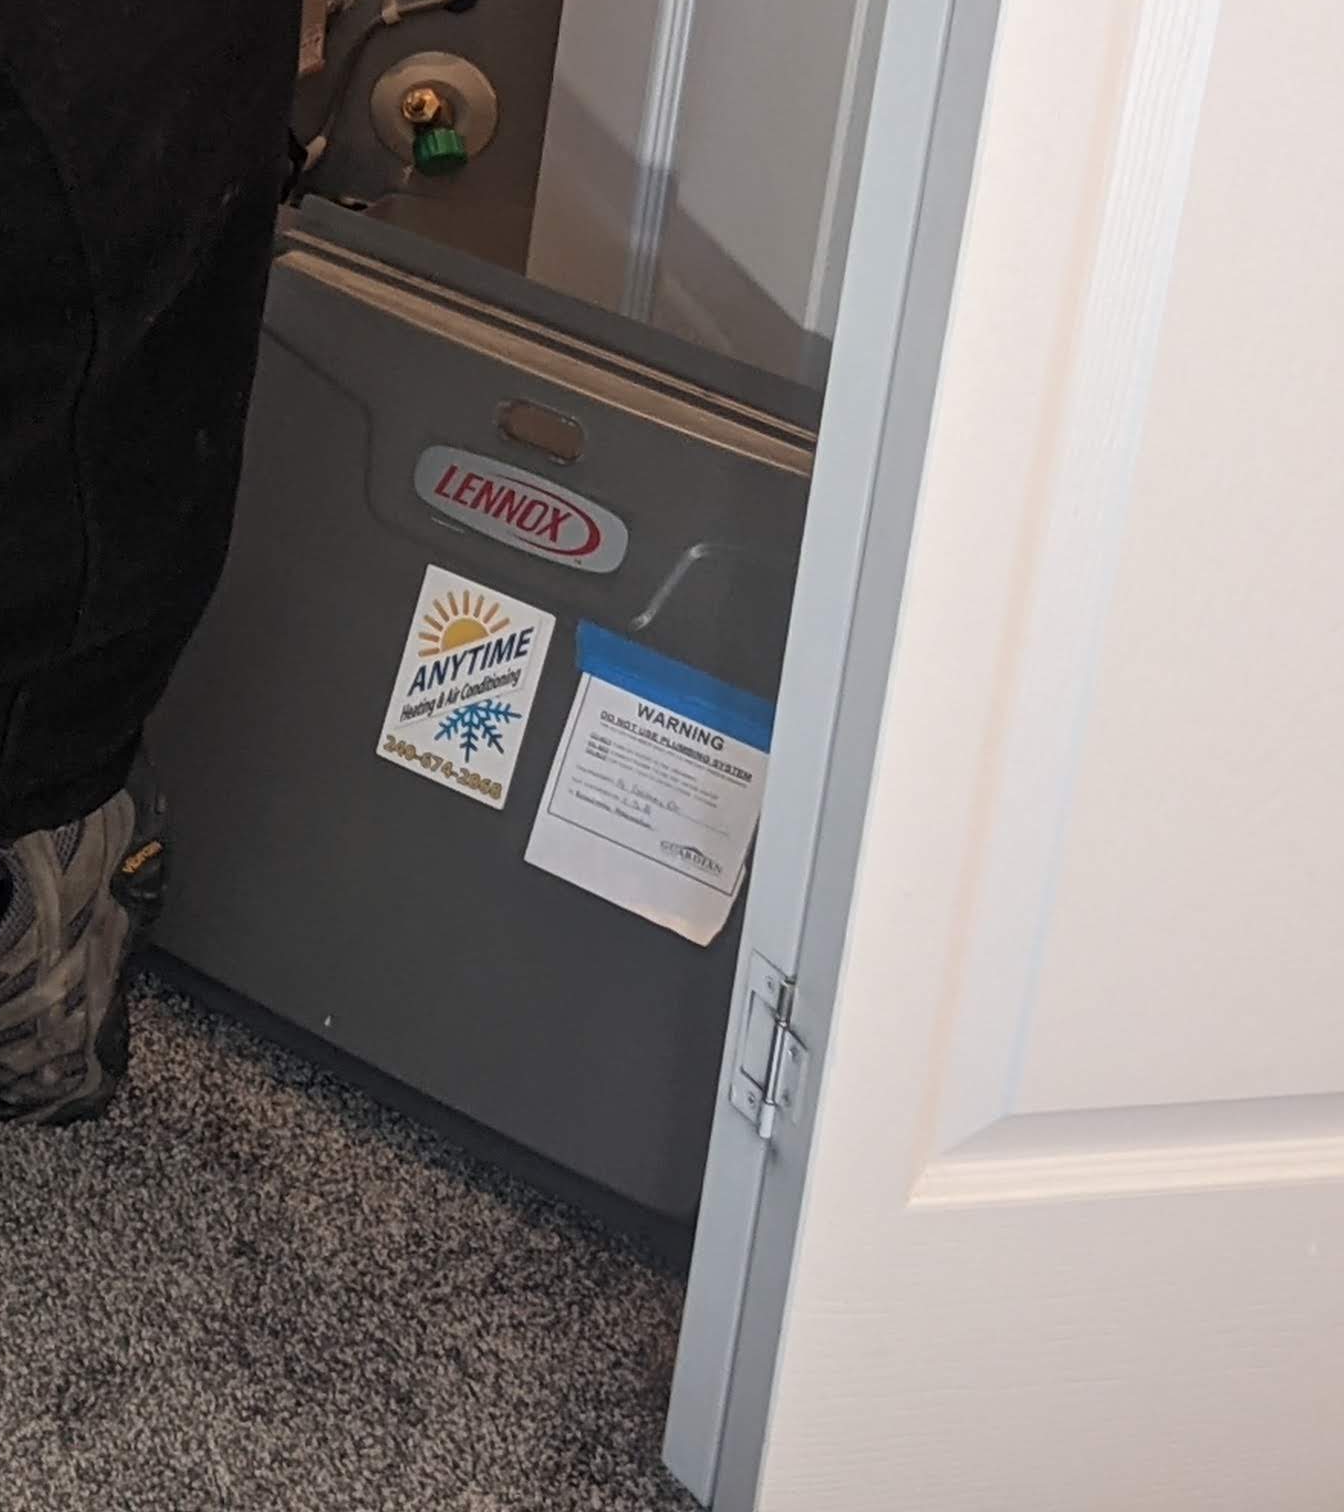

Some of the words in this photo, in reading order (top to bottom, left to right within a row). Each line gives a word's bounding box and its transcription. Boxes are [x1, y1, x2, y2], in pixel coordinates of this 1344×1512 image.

[434, 464, 572, 543] LENNOX
[408, 627, 534, 697] ANYTIME
[400, 698, 435, 722] Heating
[447, 687, 461, 705] Air
[462, 668, 522, 700] Conditioning
[600, 711, 613, 723] DO
[615, 716, 637, 733] NOT
[639, 726, 657, 741] USE
[660, 734, 710, 764] PLUMBING
[712, 758, 752, 783] SYSTEM
[638, 702, 724, 751] WARNING
[661, 840, 722, 873] GUARDIAN
